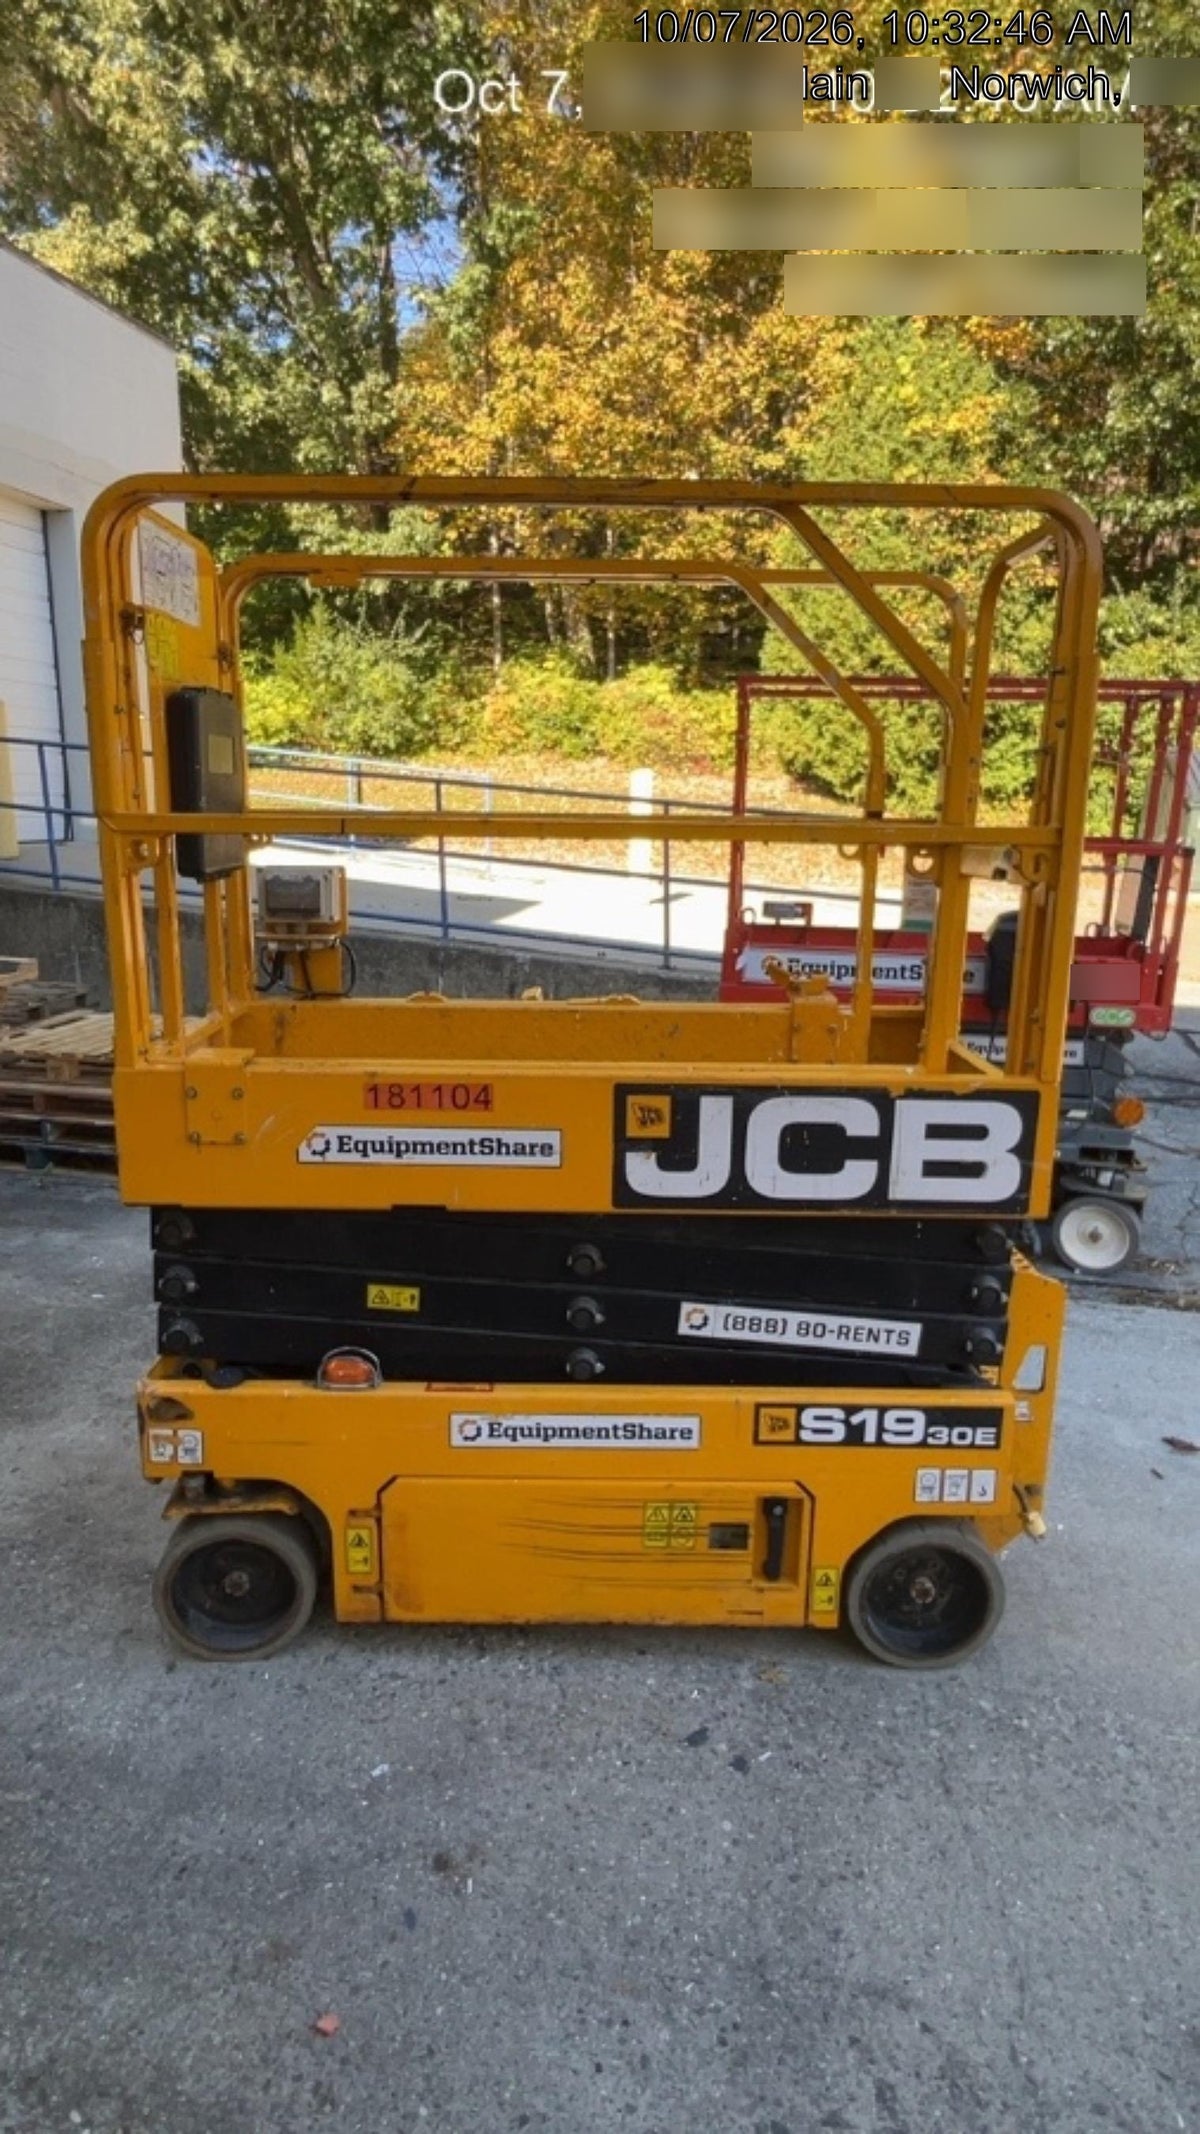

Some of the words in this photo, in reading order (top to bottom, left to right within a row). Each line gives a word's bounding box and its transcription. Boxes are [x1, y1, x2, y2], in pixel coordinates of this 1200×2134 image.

[367, 1083, 492, 1111] 181104
[336, 1135, 554, 1159] EquipmentShare
[625, 1095, 1023, 1202] JCB
[723, 1313, 788, 1336] (888)
[796, 1320, 912, 1347] 80-RENTS
[488, 1421, 694, 1442] EquipmentShare
